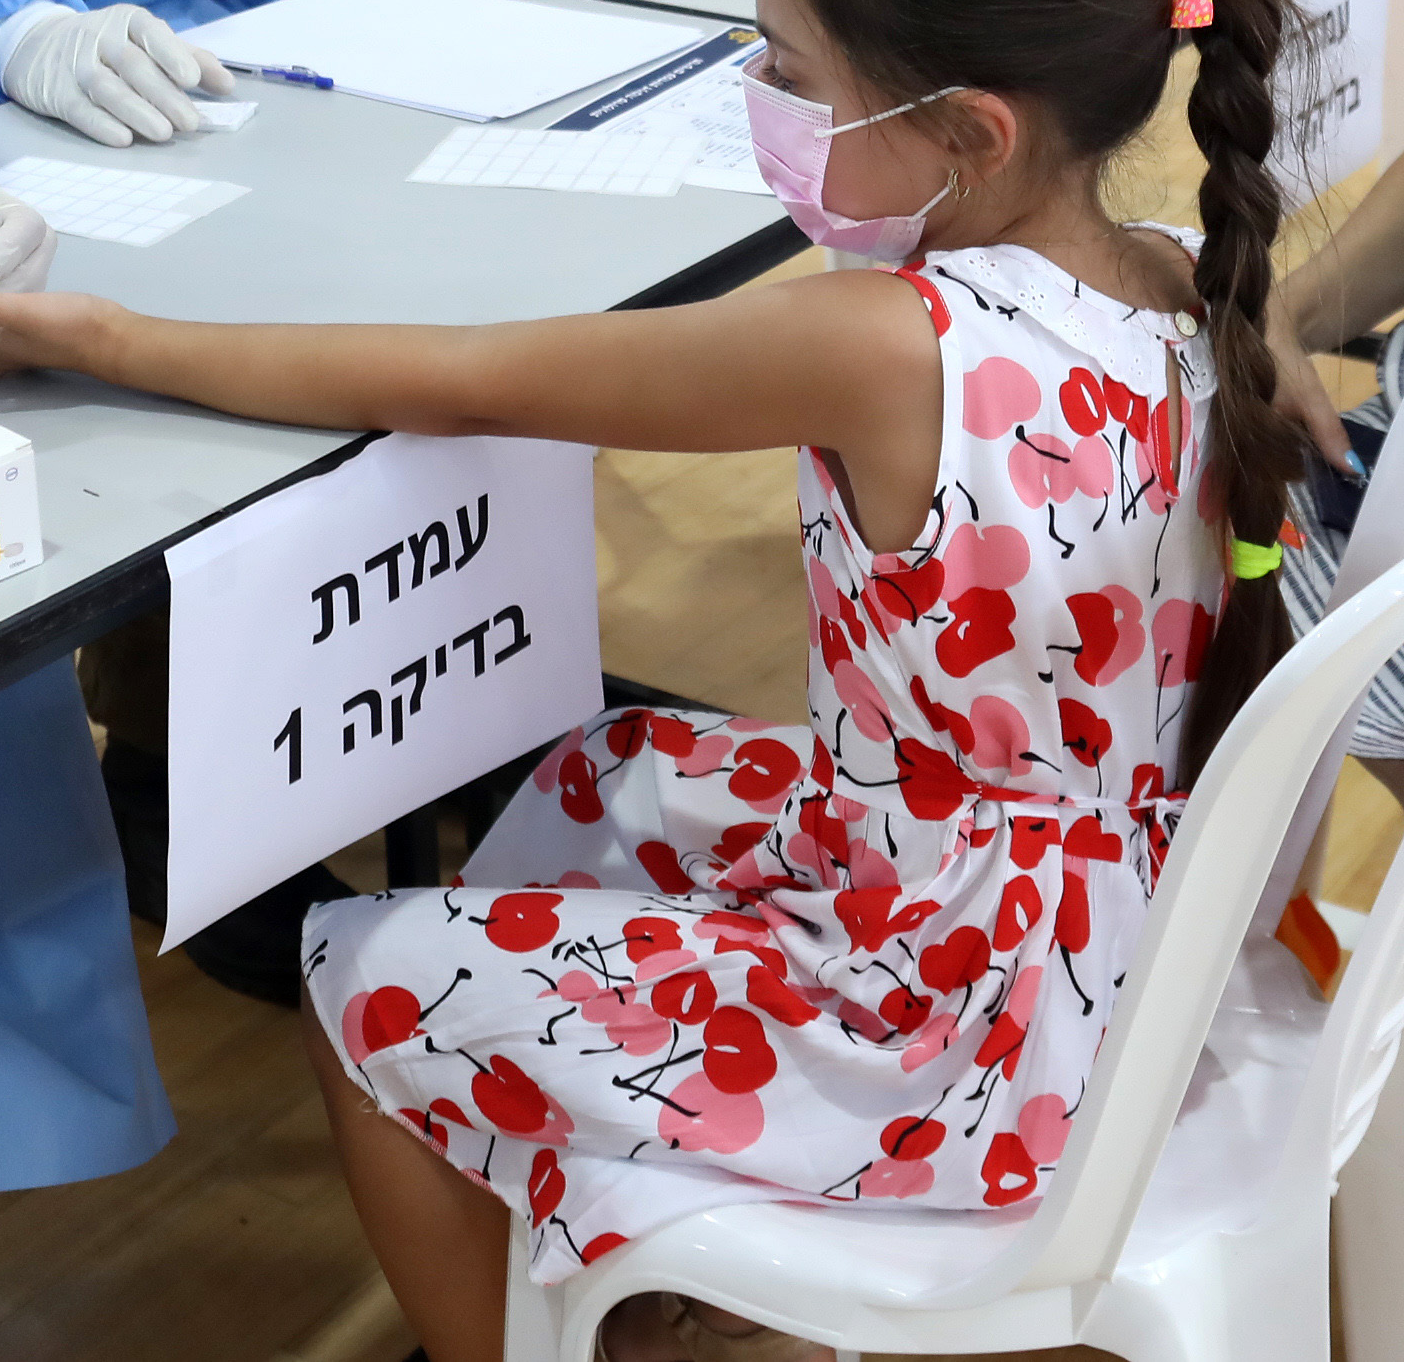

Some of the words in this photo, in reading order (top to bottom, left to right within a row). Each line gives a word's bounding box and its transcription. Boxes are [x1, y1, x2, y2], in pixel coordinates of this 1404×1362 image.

[311, 493, 489, 645] עמדת
[273, 707, 303, 785] 1
[342, 604, 532, 755] בדיקה
